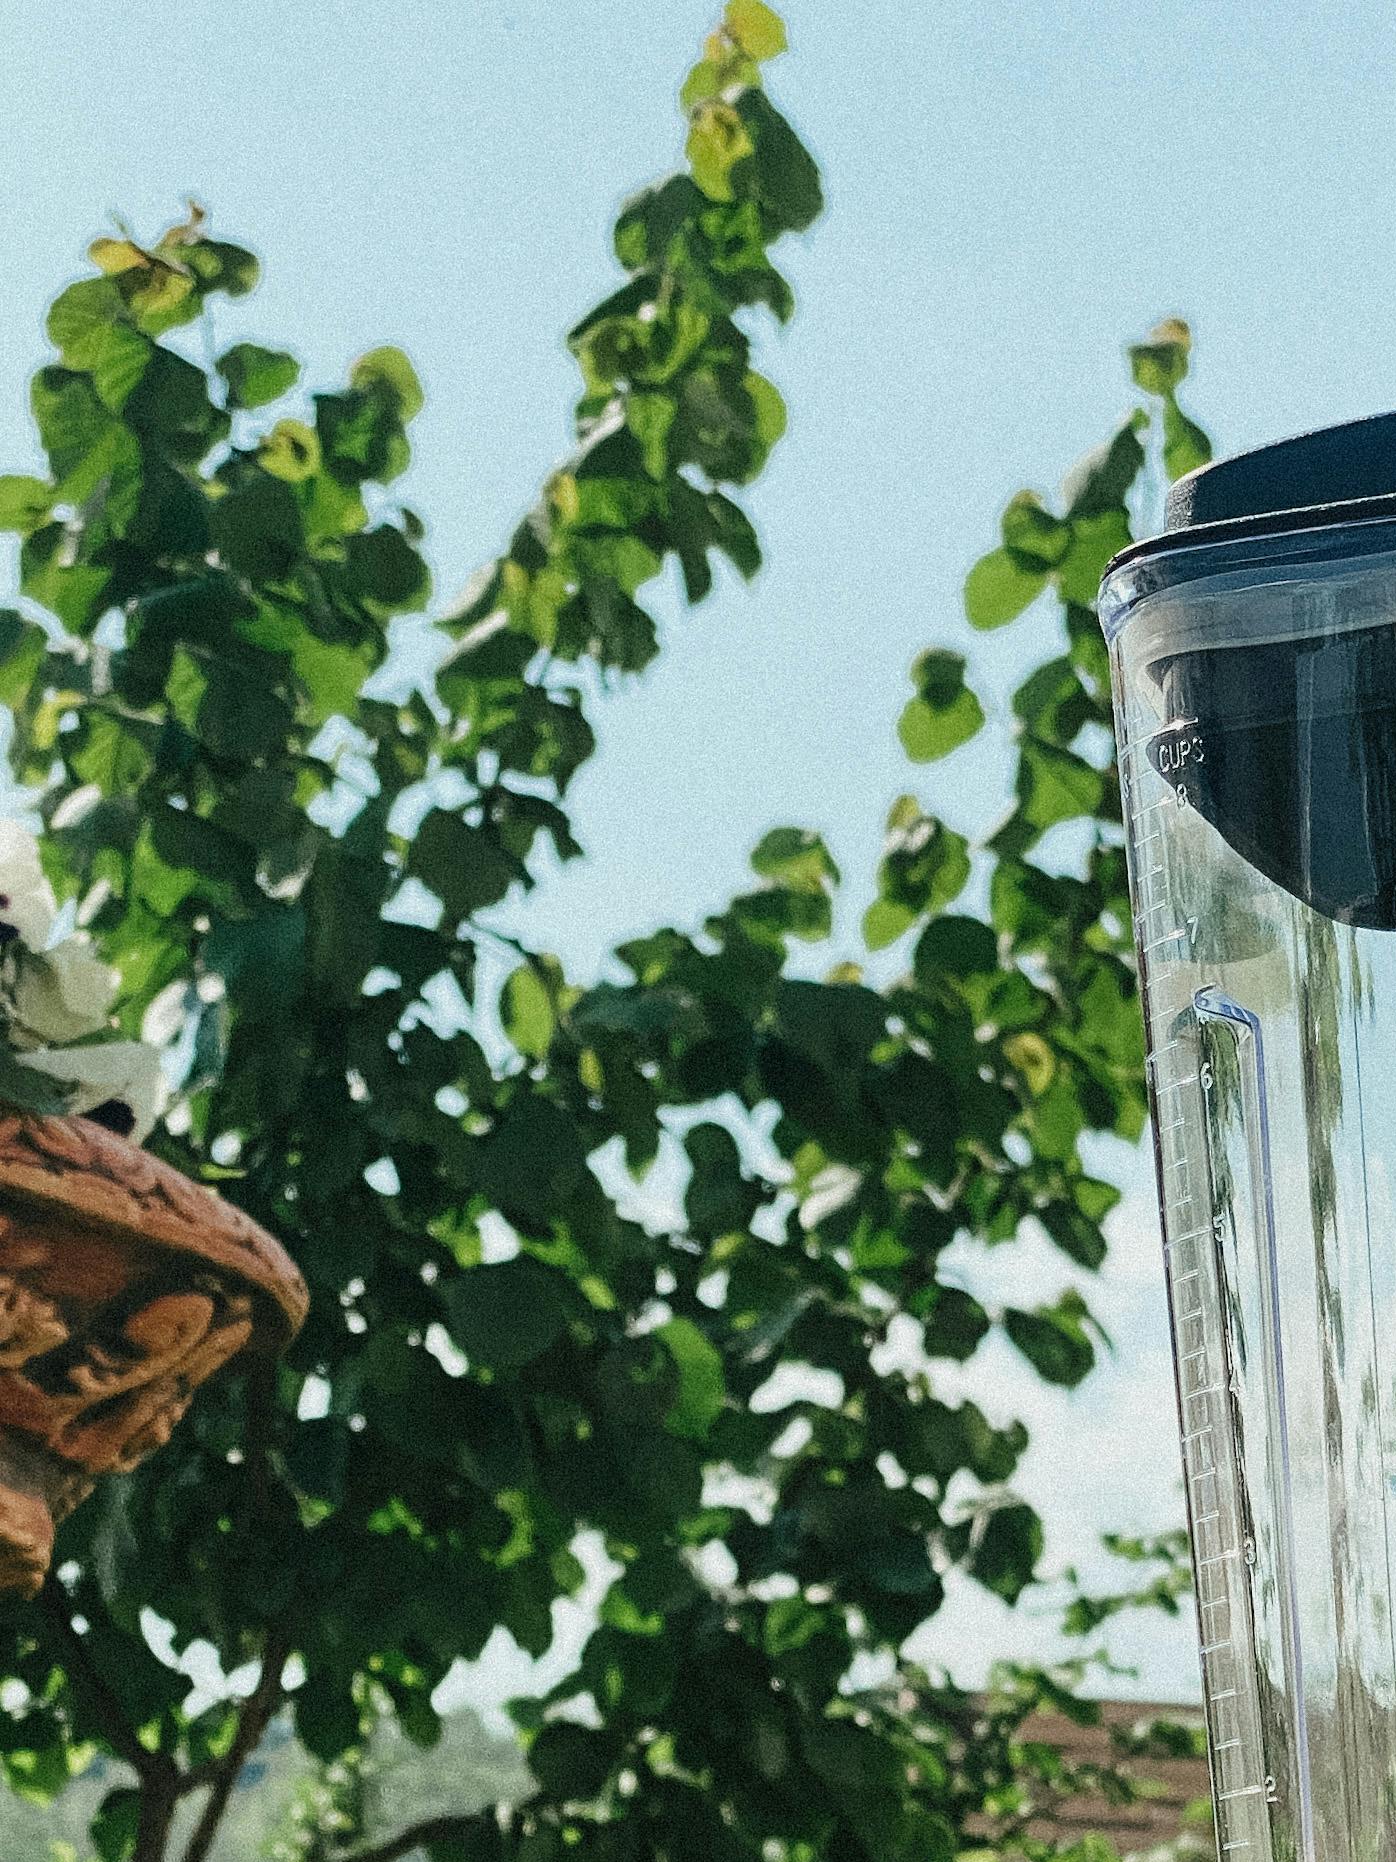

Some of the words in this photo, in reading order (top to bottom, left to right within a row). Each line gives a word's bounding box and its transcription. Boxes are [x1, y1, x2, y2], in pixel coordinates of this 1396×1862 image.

[1159, 736, 1204, 773] CUPS
[1186, 915, 1199, 945] 7
[1200, 1061, 1214, 1090] 6
[1213, 1213, 1226, 1242] 5
[1244, 1536, 1257, 1565] 3
[1265, 1774, 1279, 1802] 2
